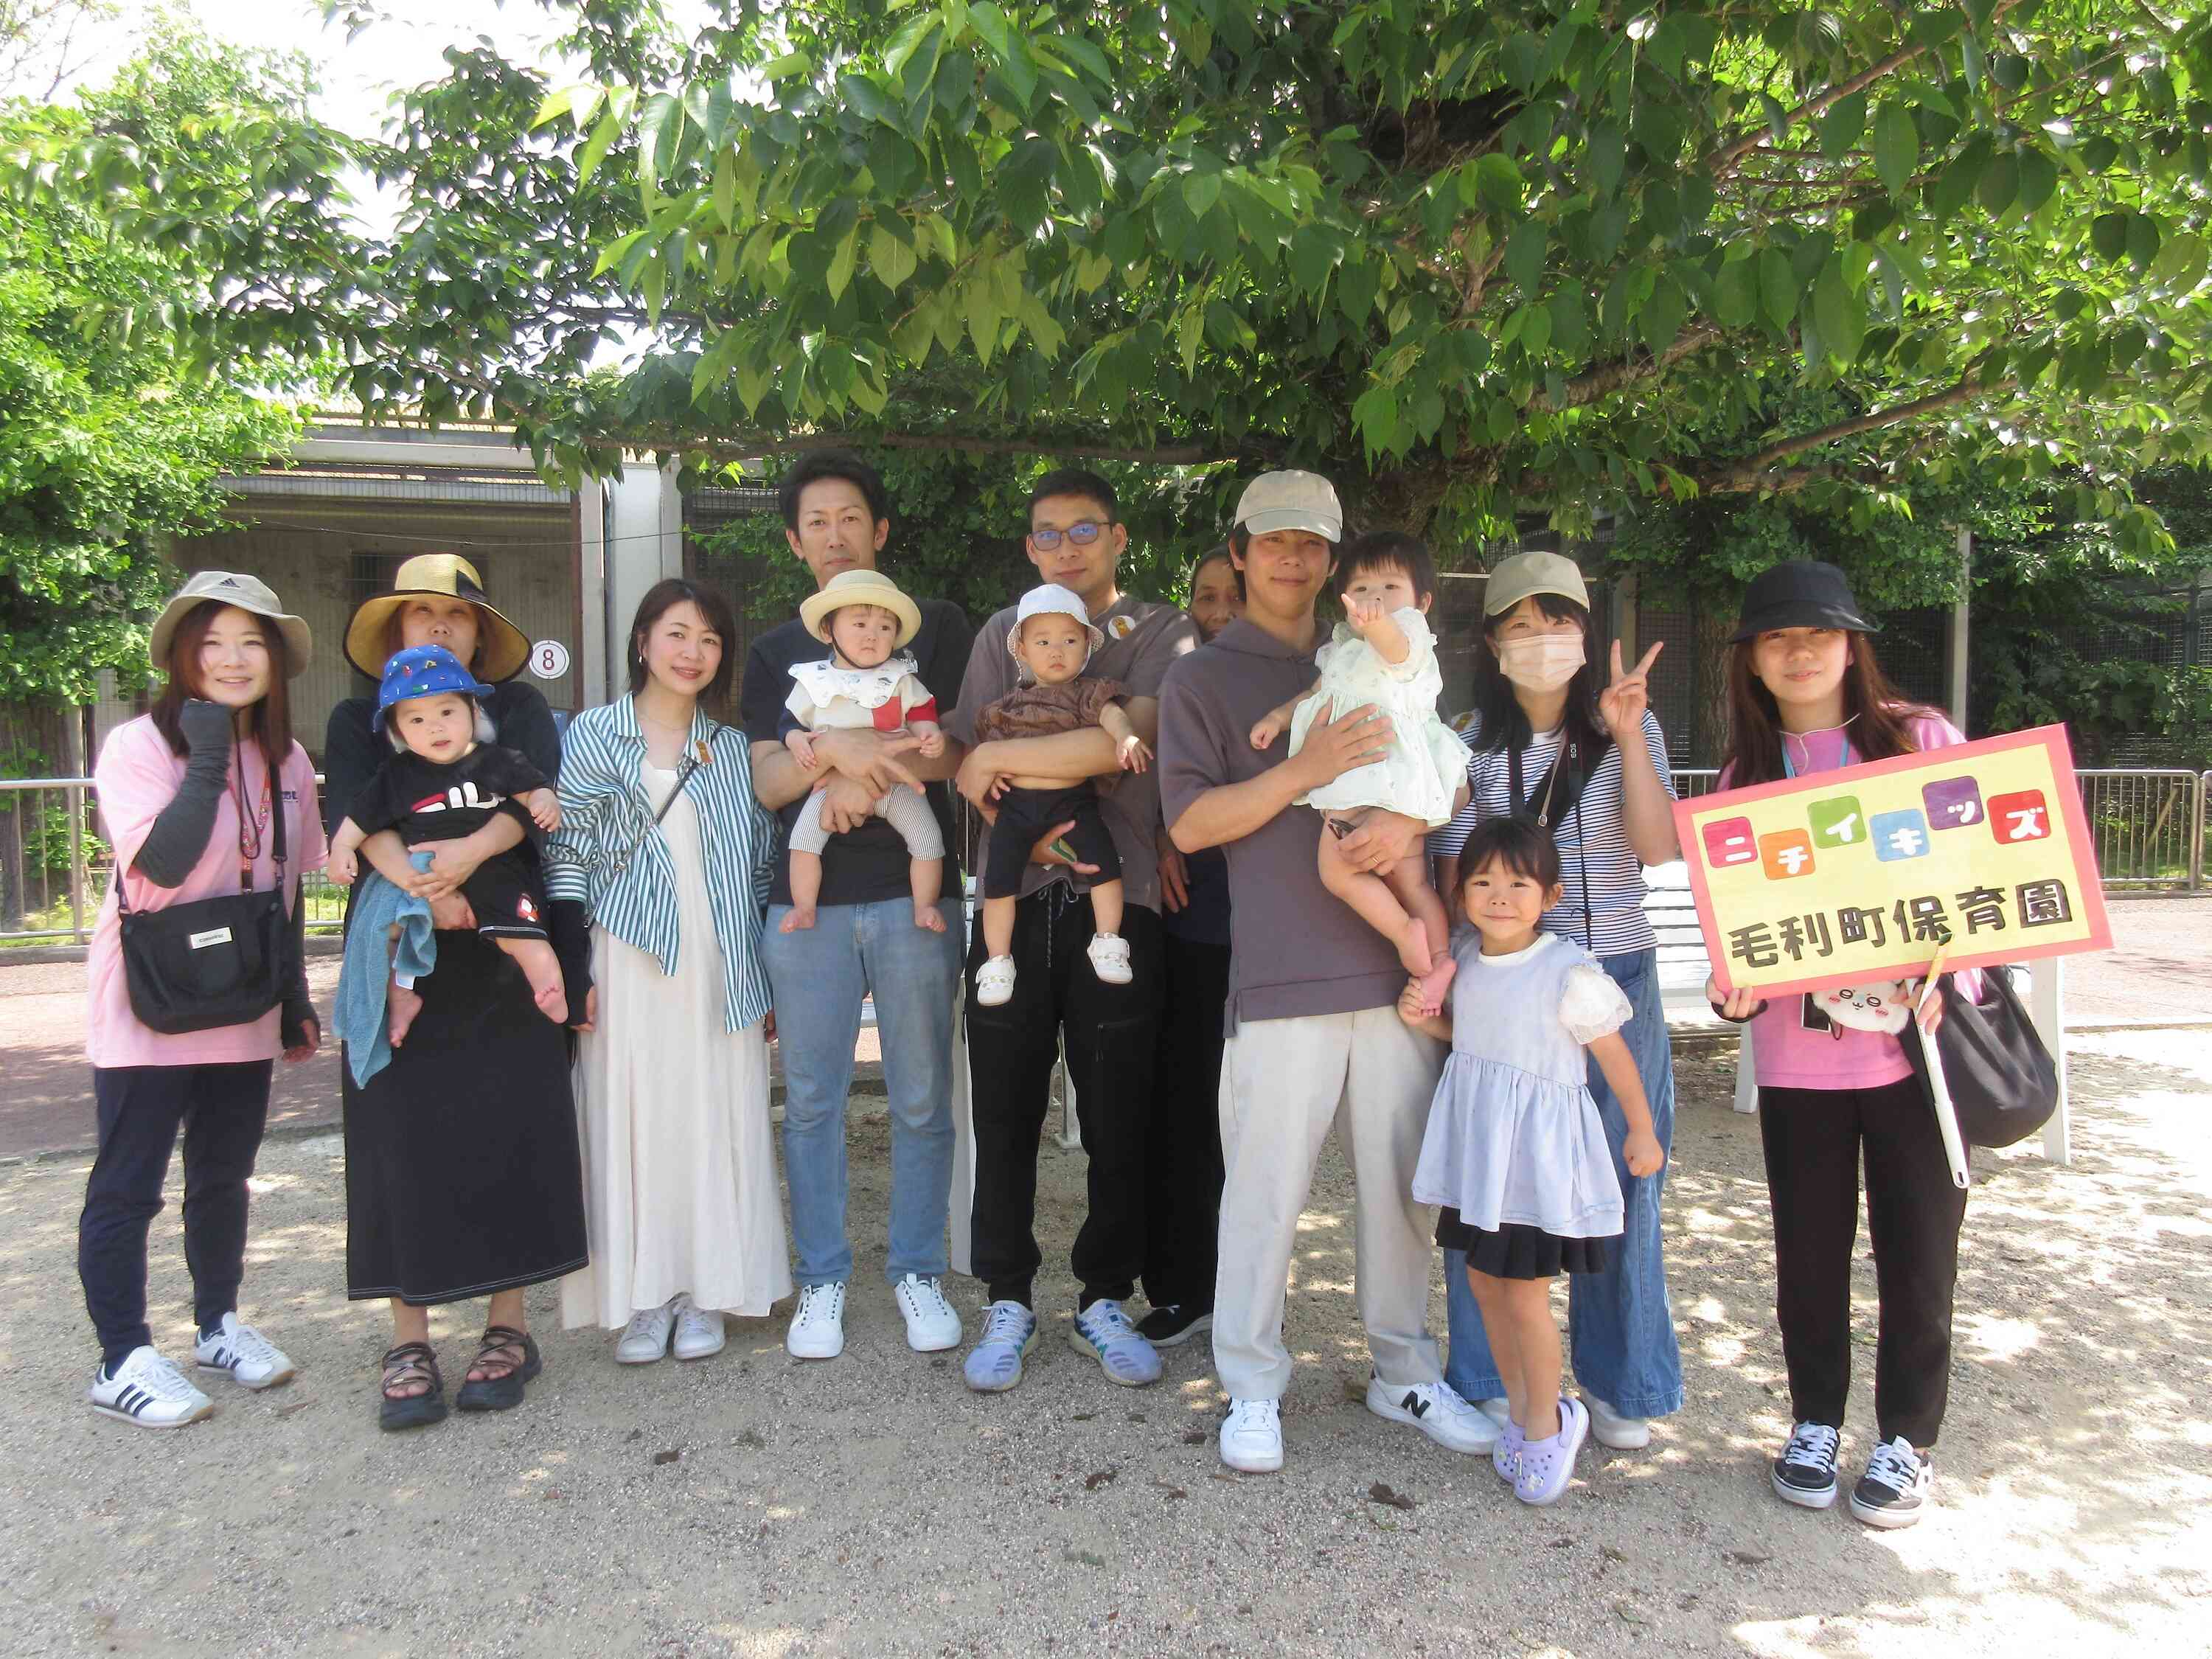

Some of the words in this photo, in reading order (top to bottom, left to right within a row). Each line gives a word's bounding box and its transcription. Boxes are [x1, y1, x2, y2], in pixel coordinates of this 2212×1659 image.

[543, 649, 554, 670] 8
[411, 782, 507, 813] FIL
[1725, 801, 2044, 874] ニチイキッズ
[1728, 878, 2073, 968] 毛利町保育園
[1401, 1390, 1431, 1419] N
